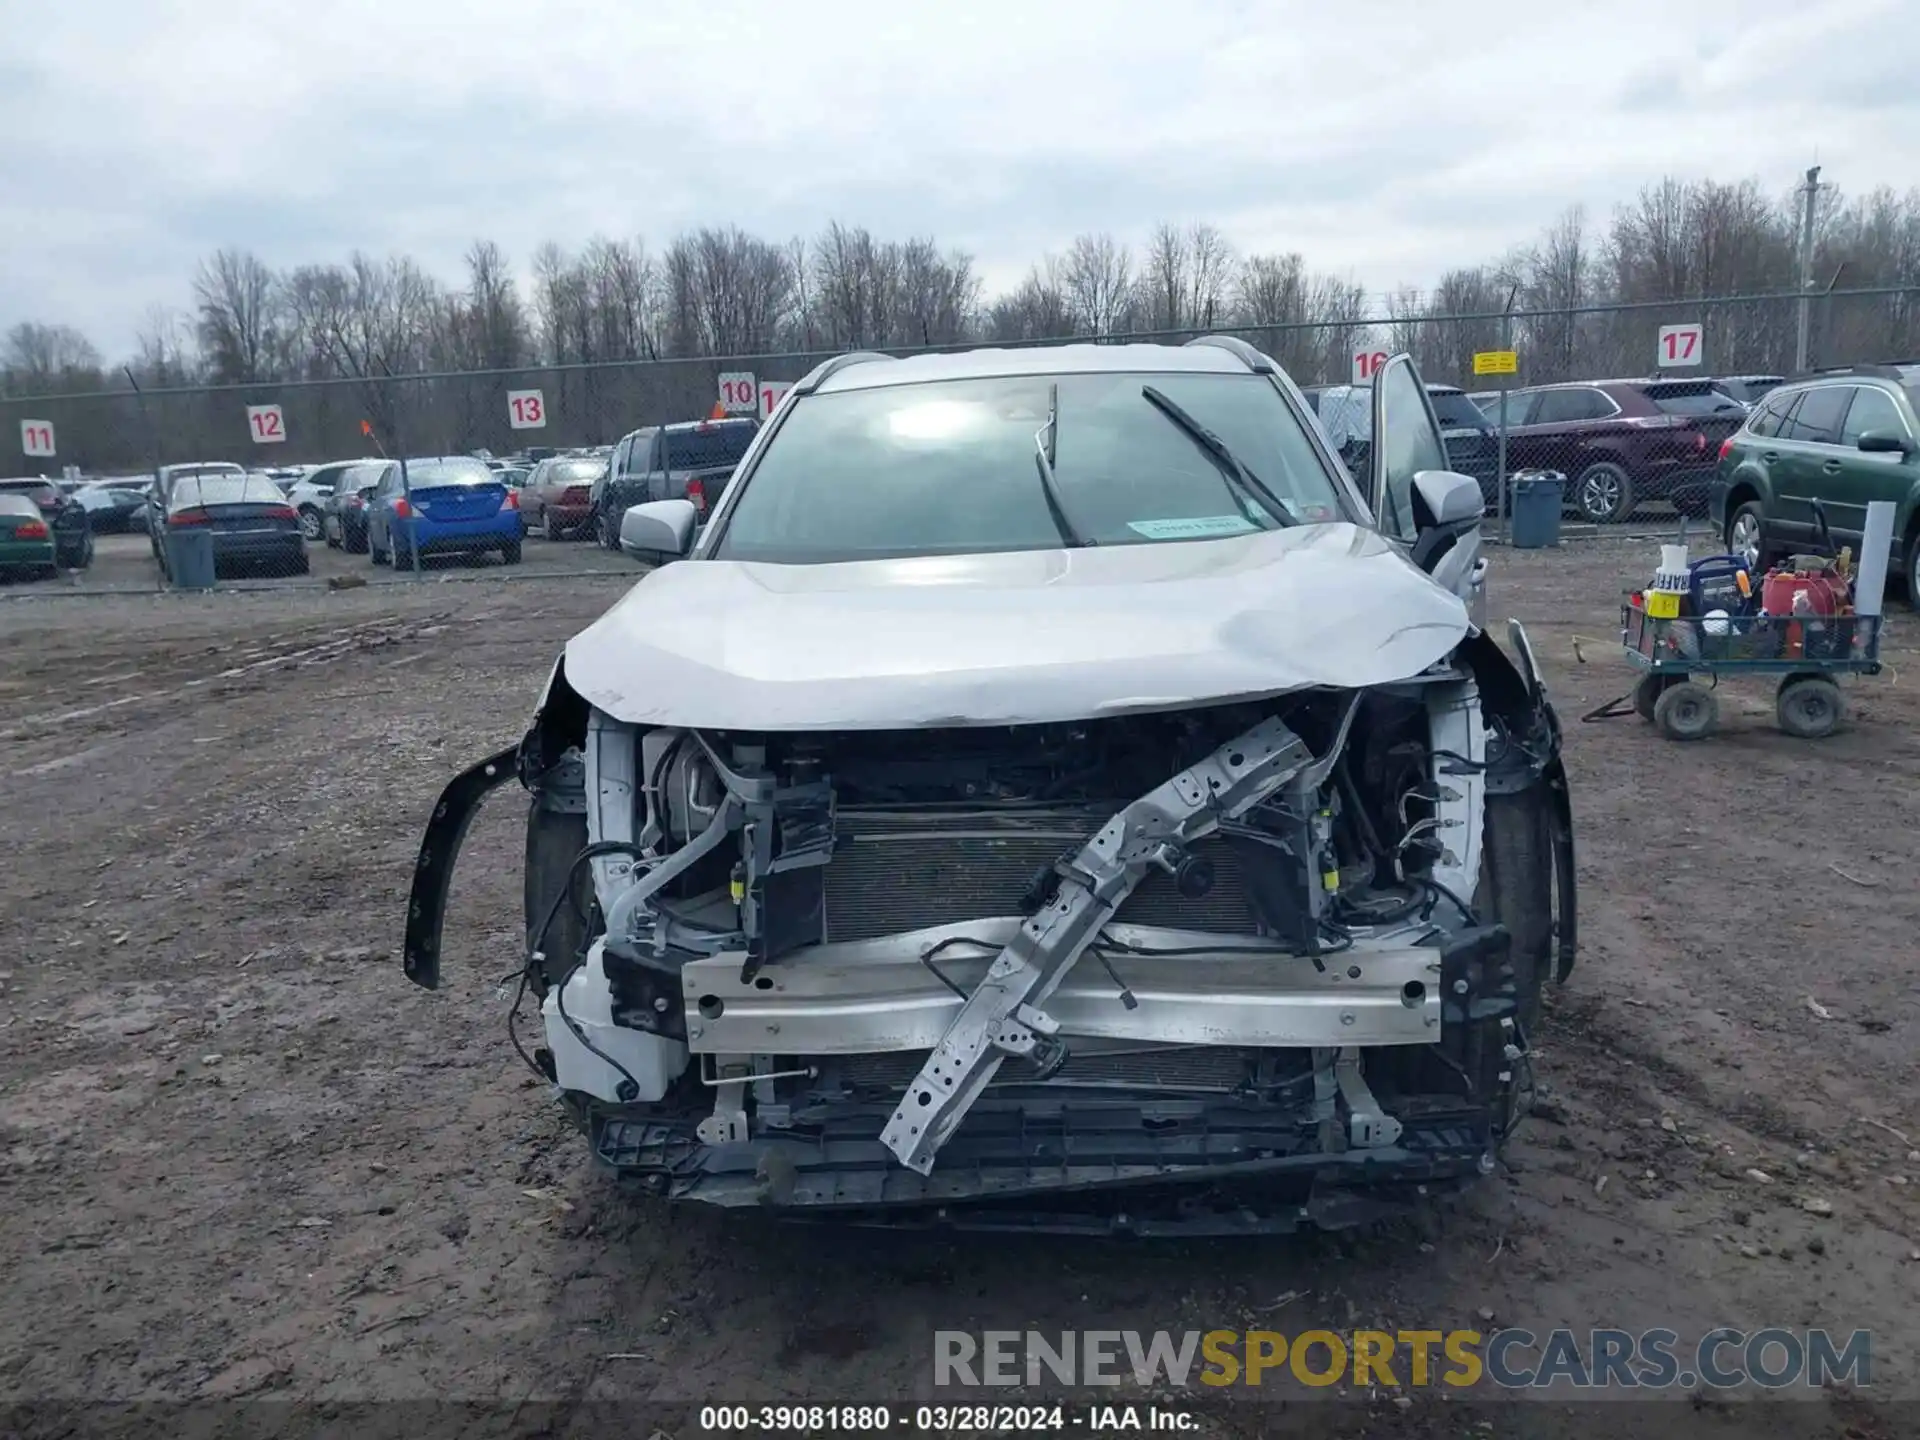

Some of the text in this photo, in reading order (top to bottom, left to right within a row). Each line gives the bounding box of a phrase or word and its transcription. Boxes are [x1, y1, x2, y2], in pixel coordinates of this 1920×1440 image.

[1663, 331, 1698, 360] 17
[722, 380, 752, 404] 10
[511, 396, 541, 422] 13
[252, 411, 282, 437] 12
[26, 427, 51, 451] 11
